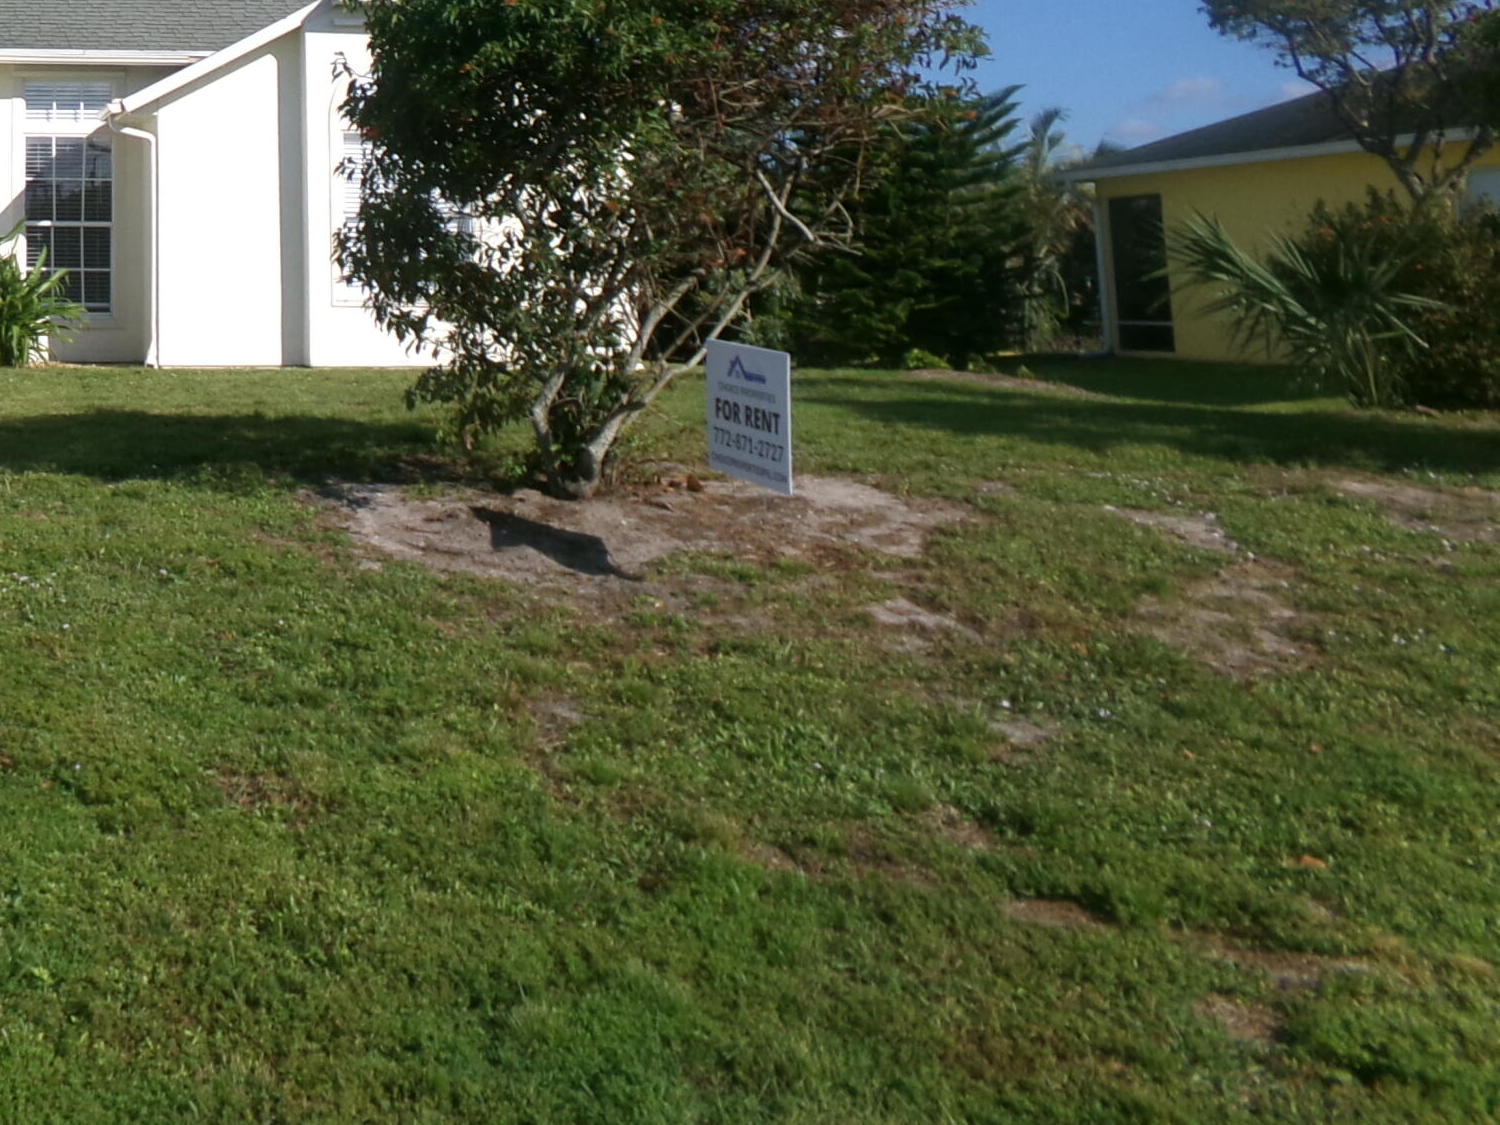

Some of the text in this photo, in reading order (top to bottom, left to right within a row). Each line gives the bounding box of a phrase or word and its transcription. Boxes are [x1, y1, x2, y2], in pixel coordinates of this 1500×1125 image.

[715, 397, 780, 435] FOR RENT
[713, 426, 784, 463] 772-871-2727
